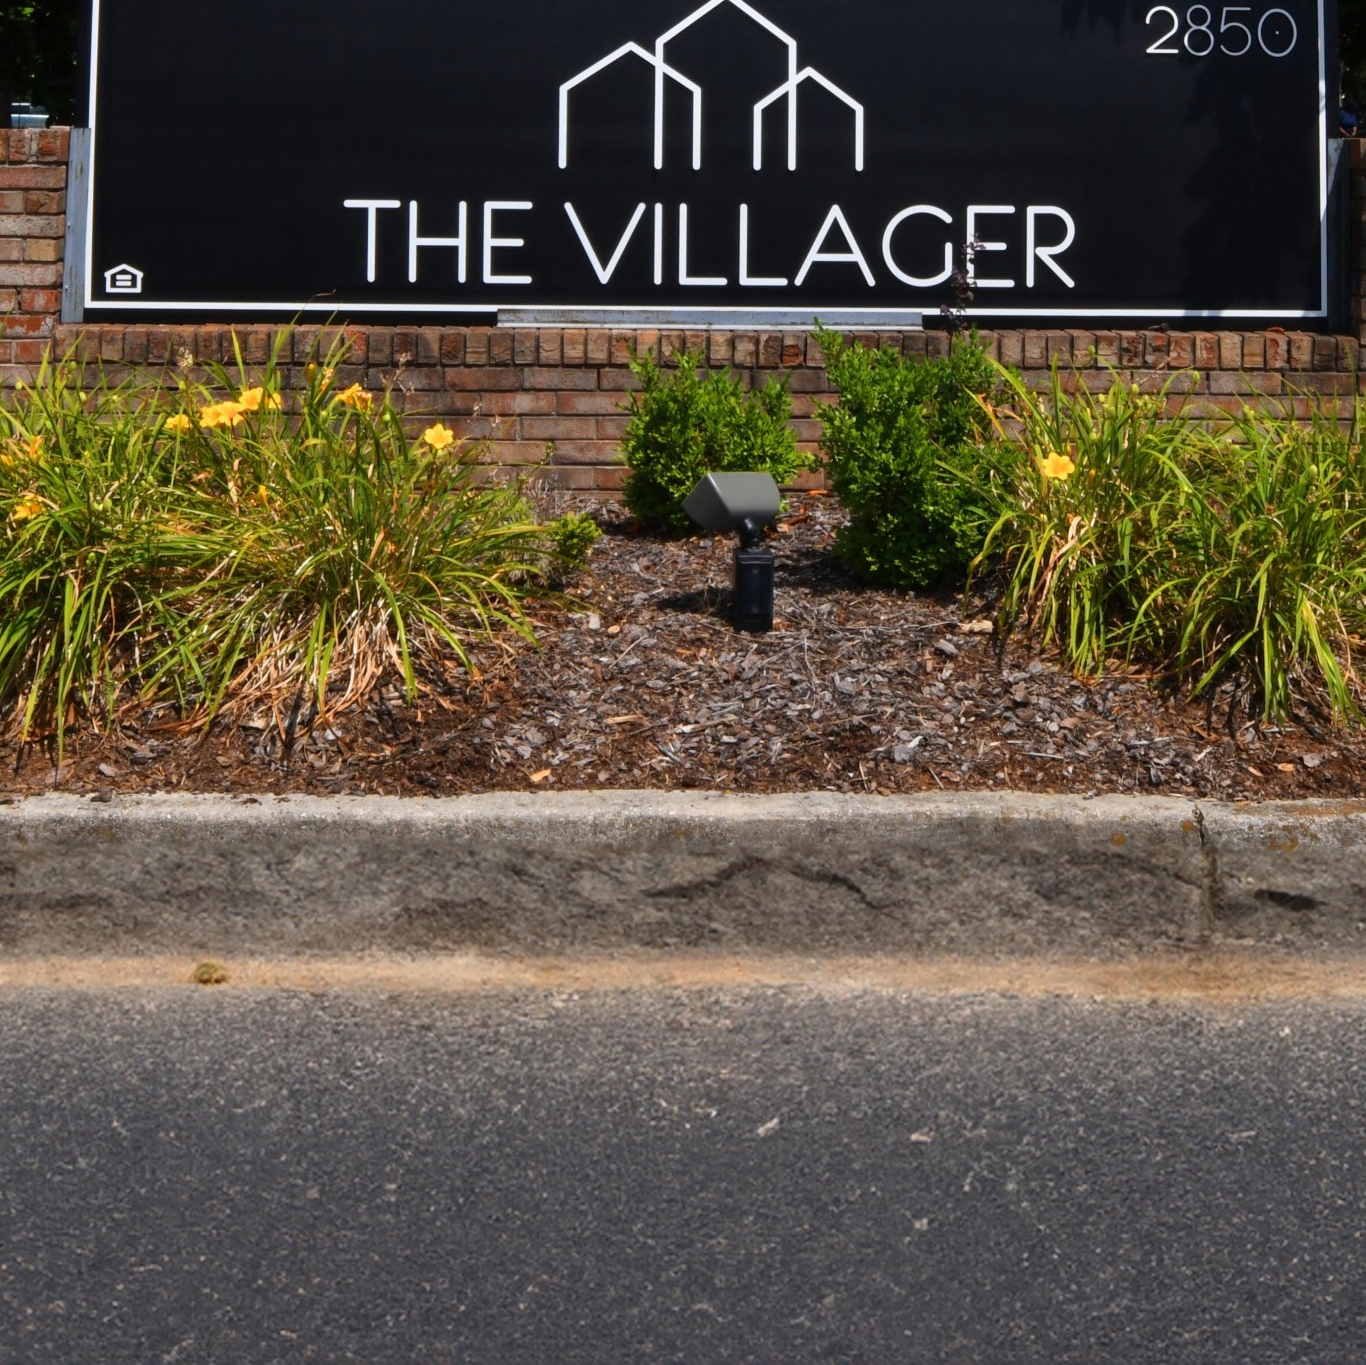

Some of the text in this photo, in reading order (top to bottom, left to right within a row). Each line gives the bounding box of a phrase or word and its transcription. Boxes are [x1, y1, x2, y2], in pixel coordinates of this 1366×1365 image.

[1145, 4, 1297, 57] 2850
[343, 199, 1075, 288] THE VILLAGER
